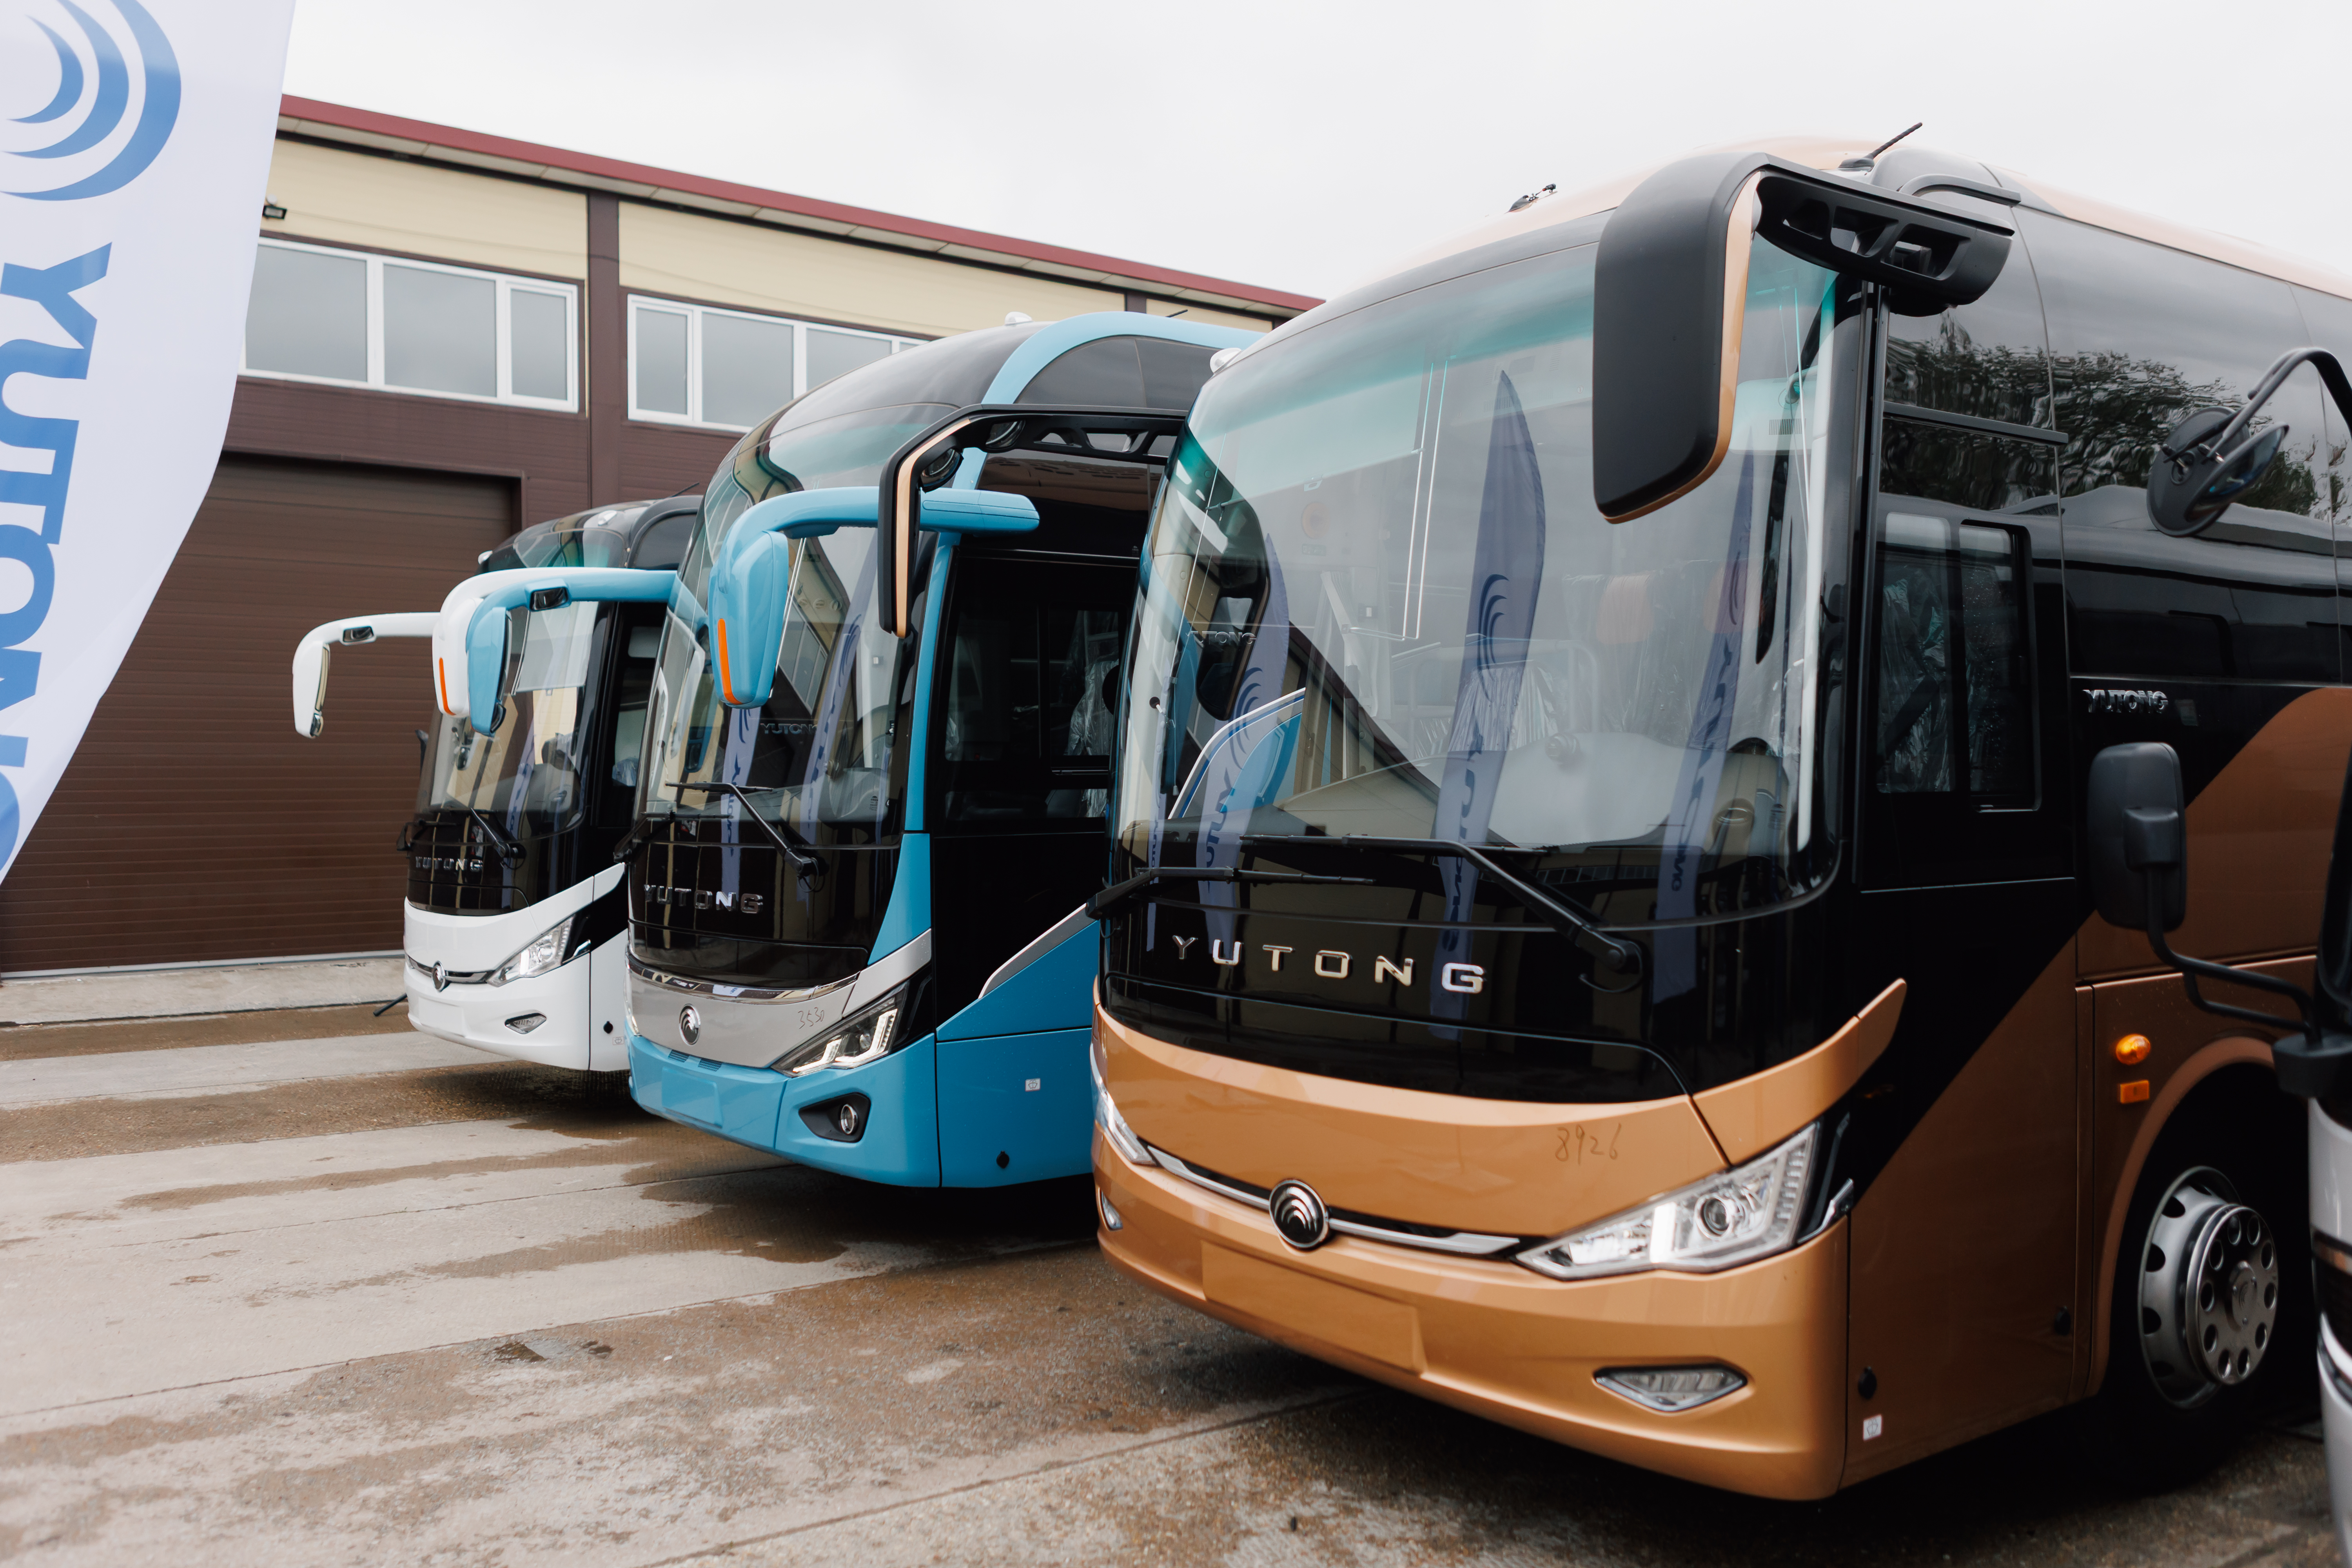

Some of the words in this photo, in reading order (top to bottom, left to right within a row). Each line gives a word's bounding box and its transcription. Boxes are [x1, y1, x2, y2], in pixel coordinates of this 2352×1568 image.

[2082, 690, 2168, 713] YUTONG
[416, 856, 483, 871] YUTONG
[643, 884, 763, 914] YUTONG
[1172, 935, 1486, 994] YUTONG
[1555, 1122, 1621, 1165] 8926
